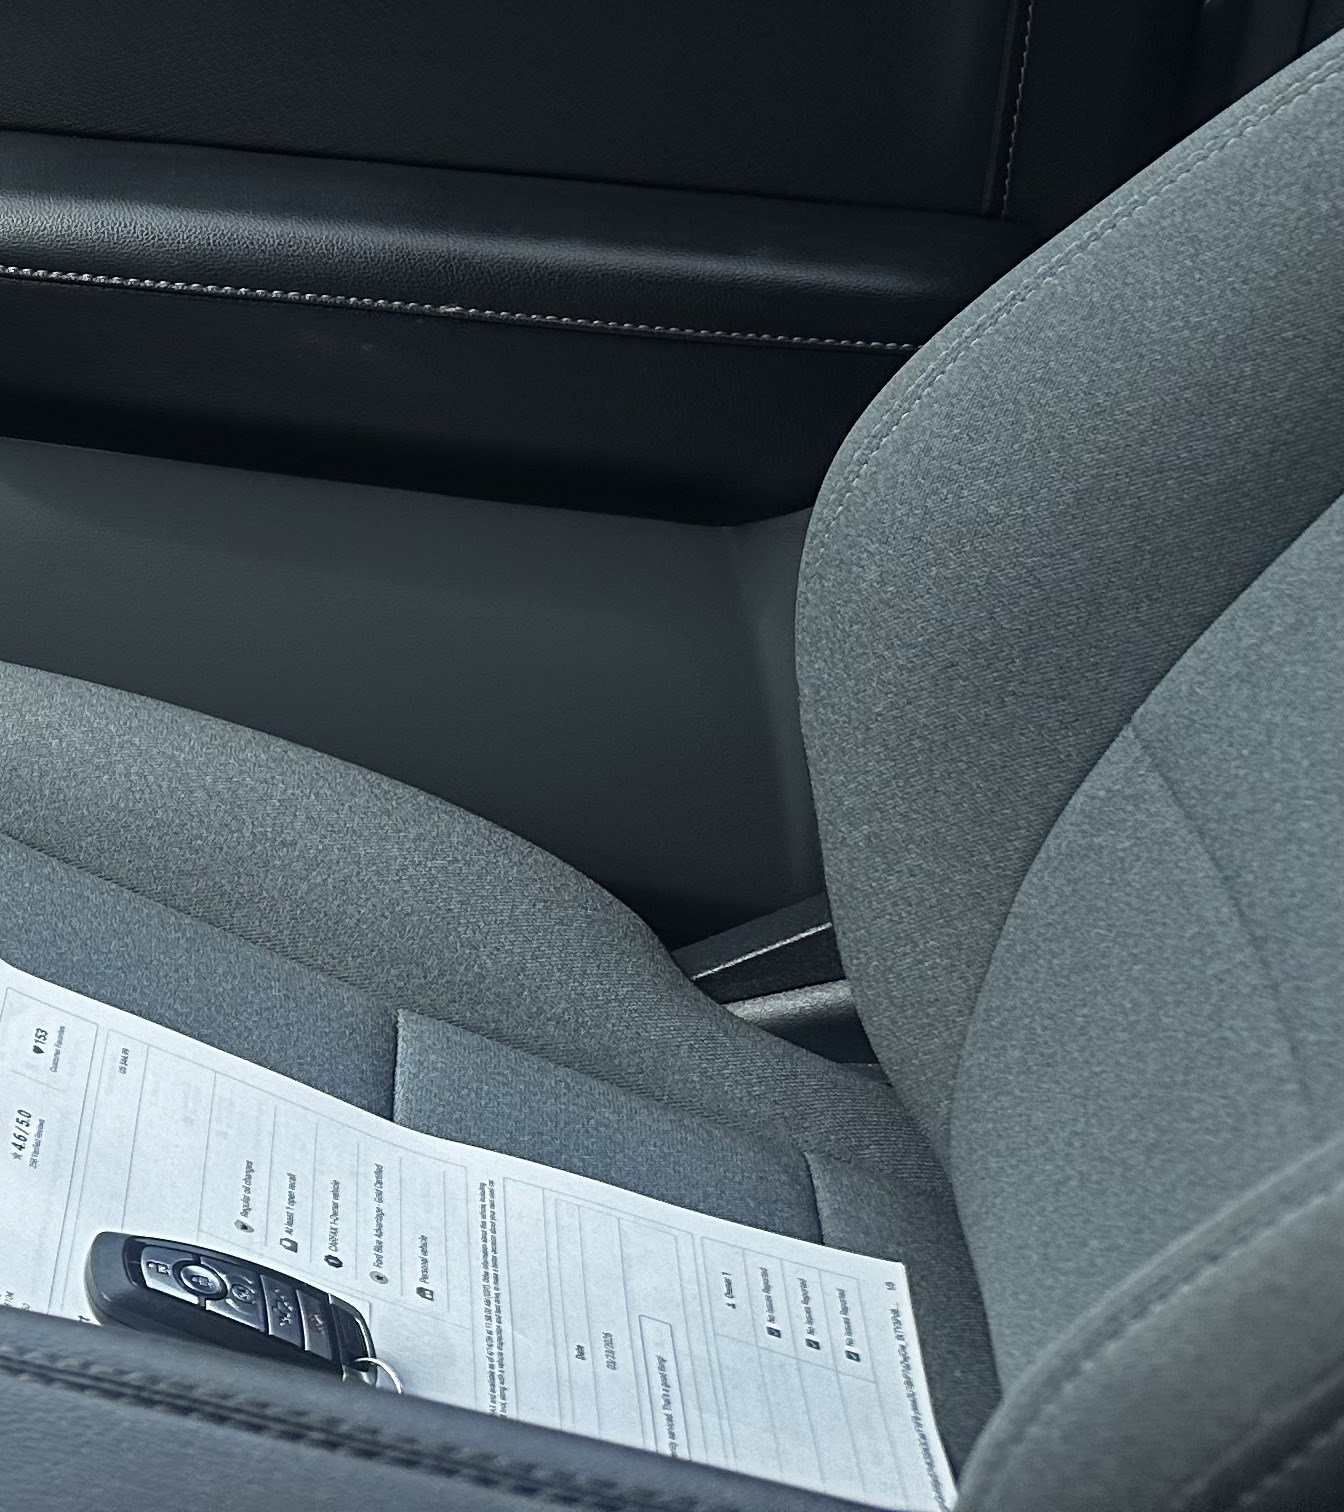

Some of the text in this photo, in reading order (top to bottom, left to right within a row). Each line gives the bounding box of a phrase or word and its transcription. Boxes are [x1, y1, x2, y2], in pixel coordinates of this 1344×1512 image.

[35, 1029, 47, 1044] 153
[12, 1110, 31, 1150] 4.6 / 5.0
[419, 1235, 428, 1284] Personal vehicle
